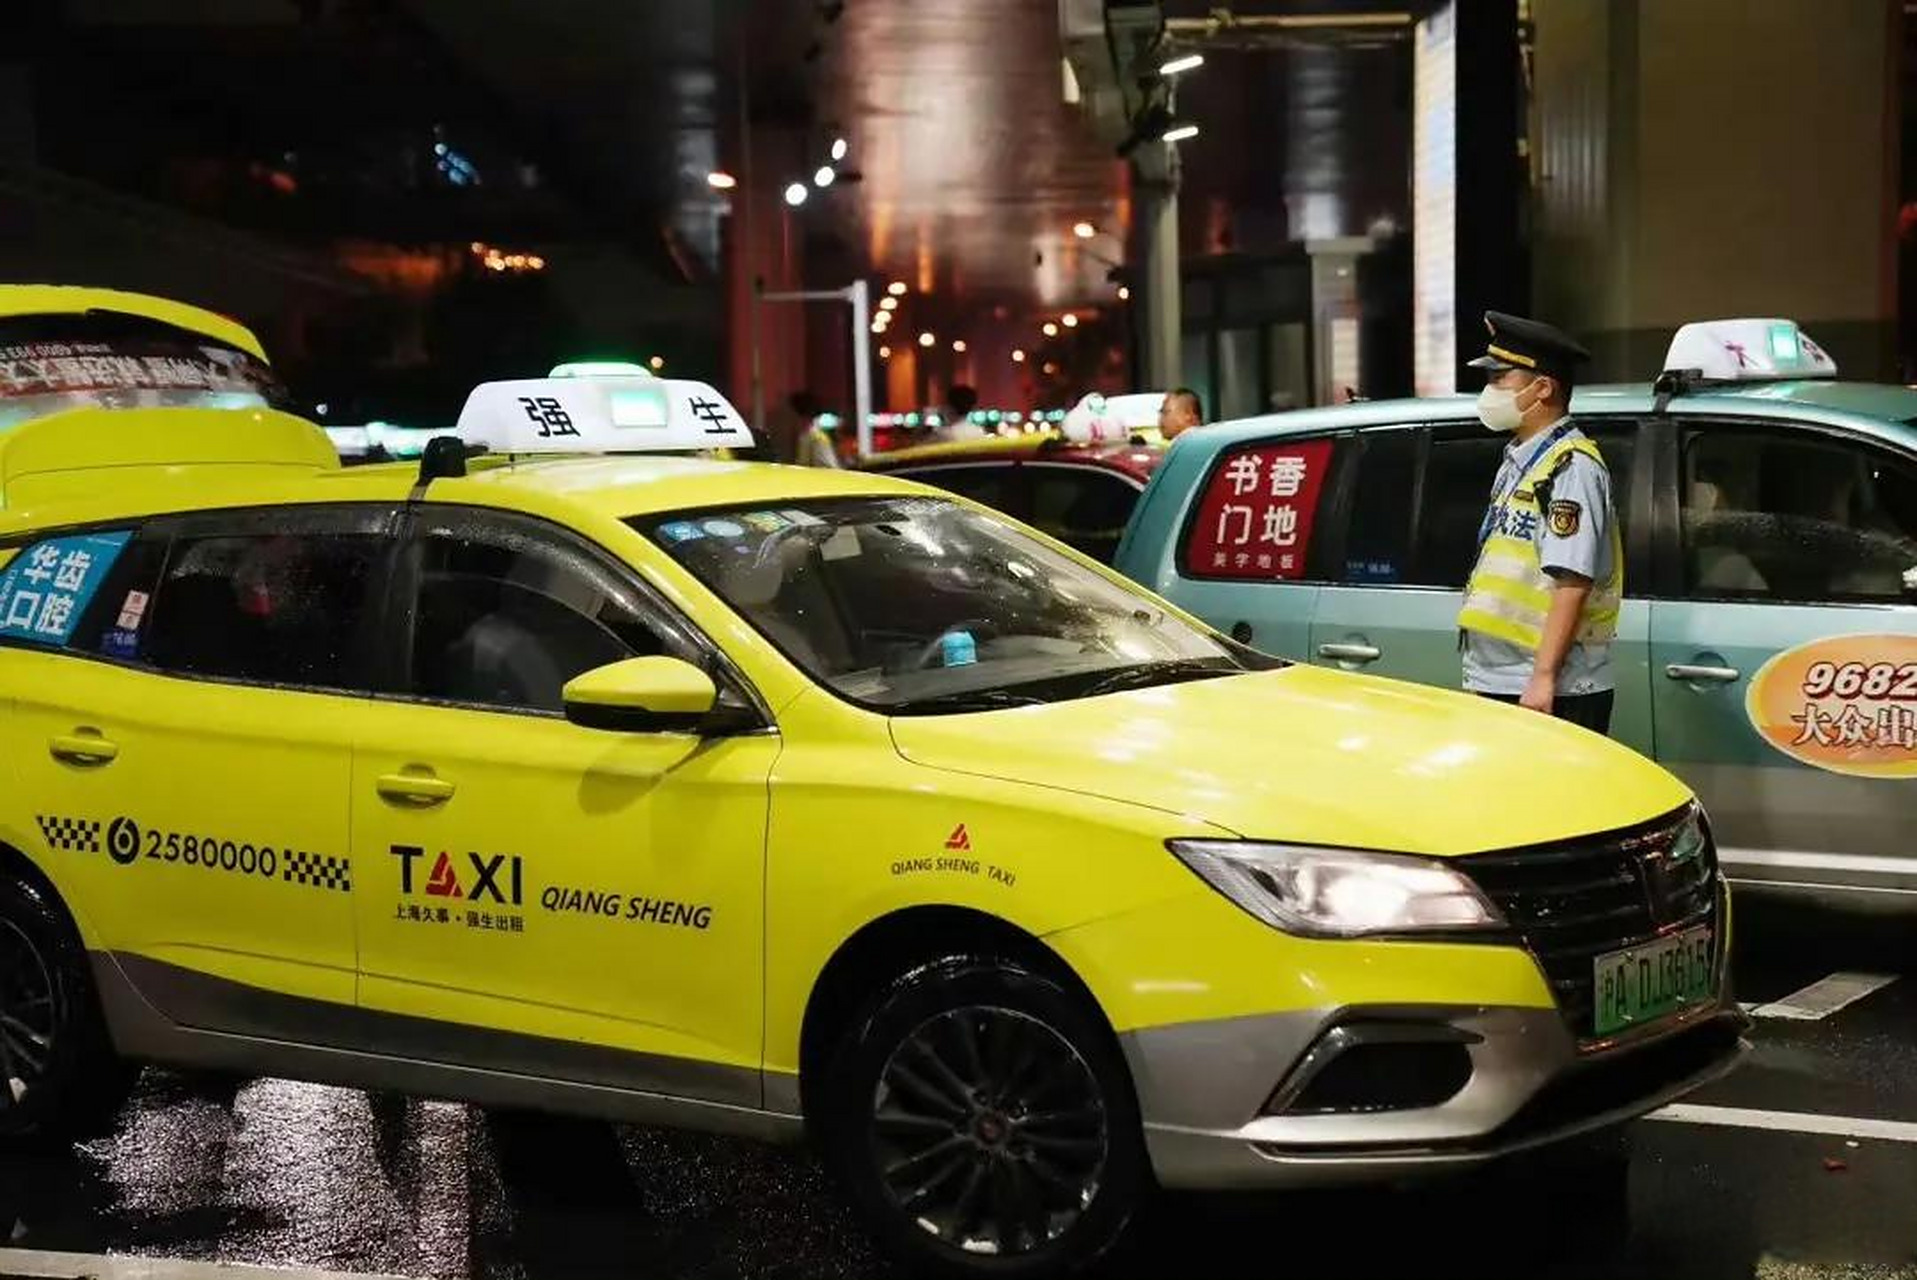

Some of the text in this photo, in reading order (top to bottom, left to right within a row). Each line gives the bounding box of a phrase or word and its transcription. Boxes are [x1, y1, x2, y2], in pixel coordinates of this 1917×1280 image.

[518, 396, 737, 437] 强 生
[1225, 455, 1306, 496] 书香
[1216, 504, 1297, 545] 门地
[23, 544, 92, 592] 华齿
[6, 590, 75, 635] 口腔
[1790, 703, 1914, 749] 大众出
[390, 845, 523, 905] TAXI
[892, 857, 1016, 887] QIANG SHENG TAXI
[541, 887, 712, 930] QIANG SHENG
